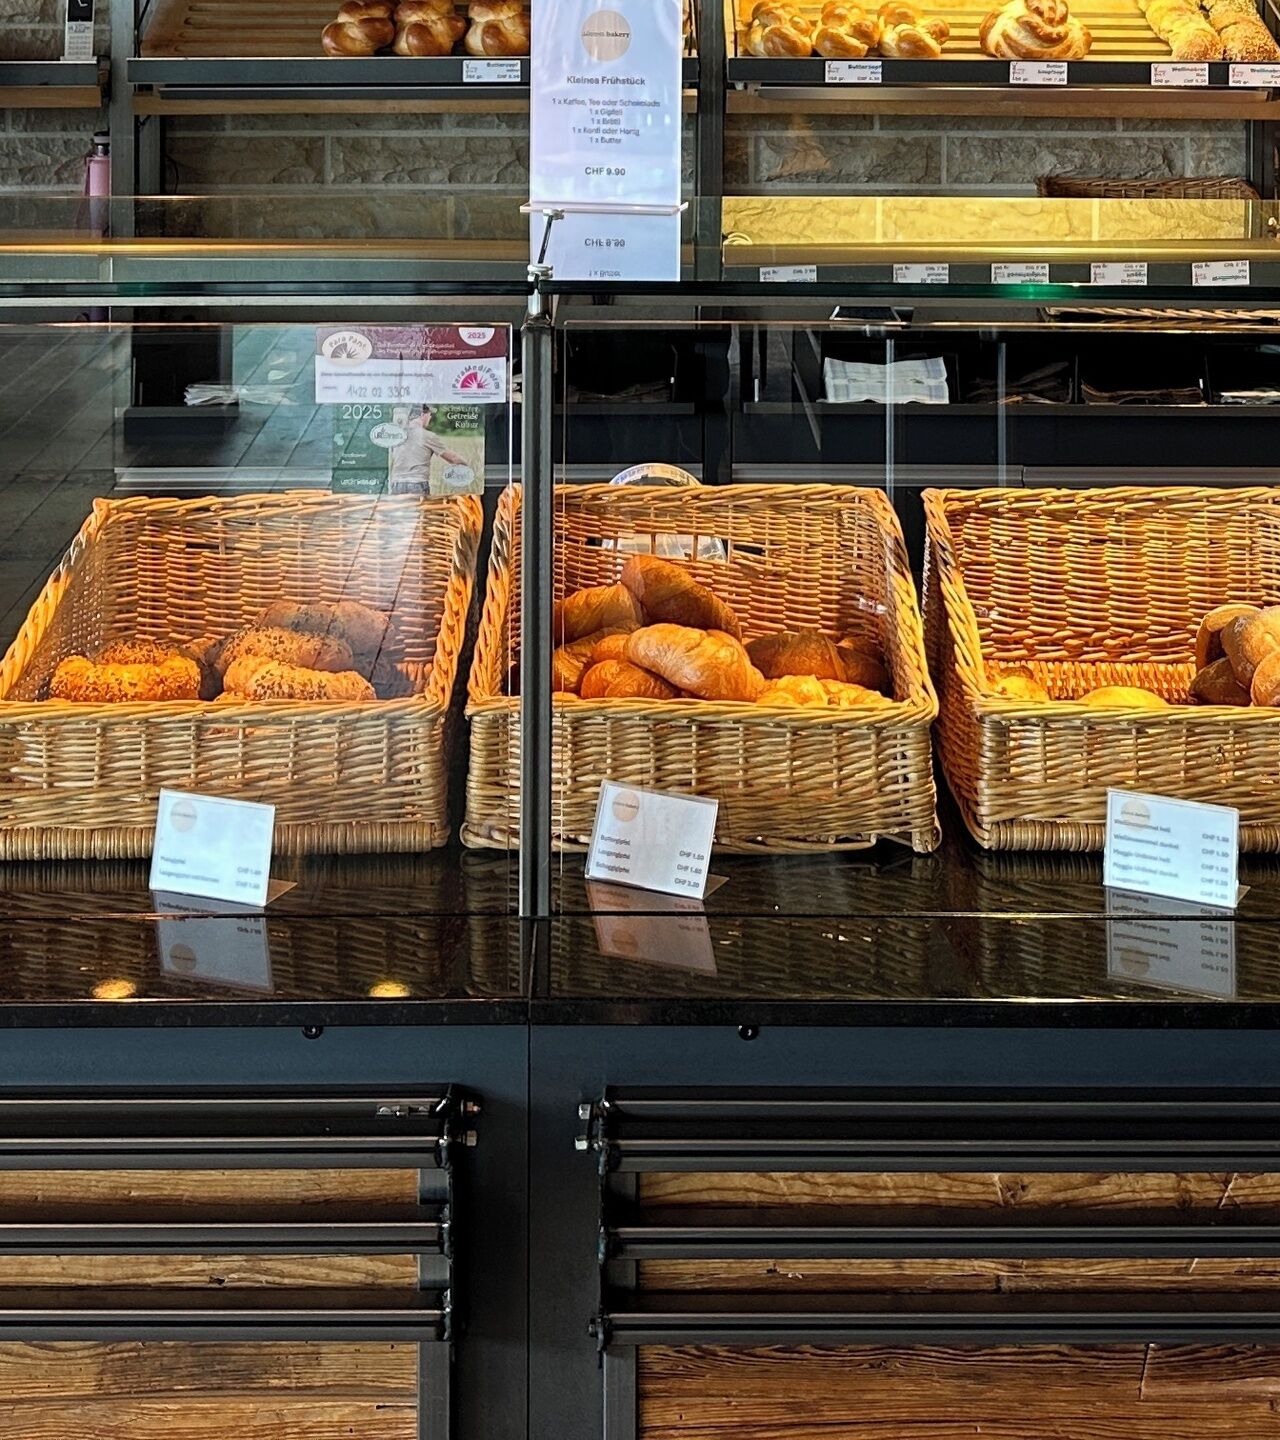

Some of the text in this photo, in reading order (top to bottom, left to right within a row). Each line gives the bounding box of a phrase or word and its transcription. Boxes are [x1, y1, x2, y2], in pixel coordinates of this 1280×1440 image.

[567, 75, 646, 86] Kleines Frühstück
[620, 128, 639, 136] Honig
[585, 167, 626, 176] CHF 9.90
[451, 364, 500, 390] ParaMediForm
[342, 404, 382, 419] 2025
[447, 412, 479, 420] Getreide
[455, 420, 479, 428] Kultur
[679, 850, 691, 858] CHF
